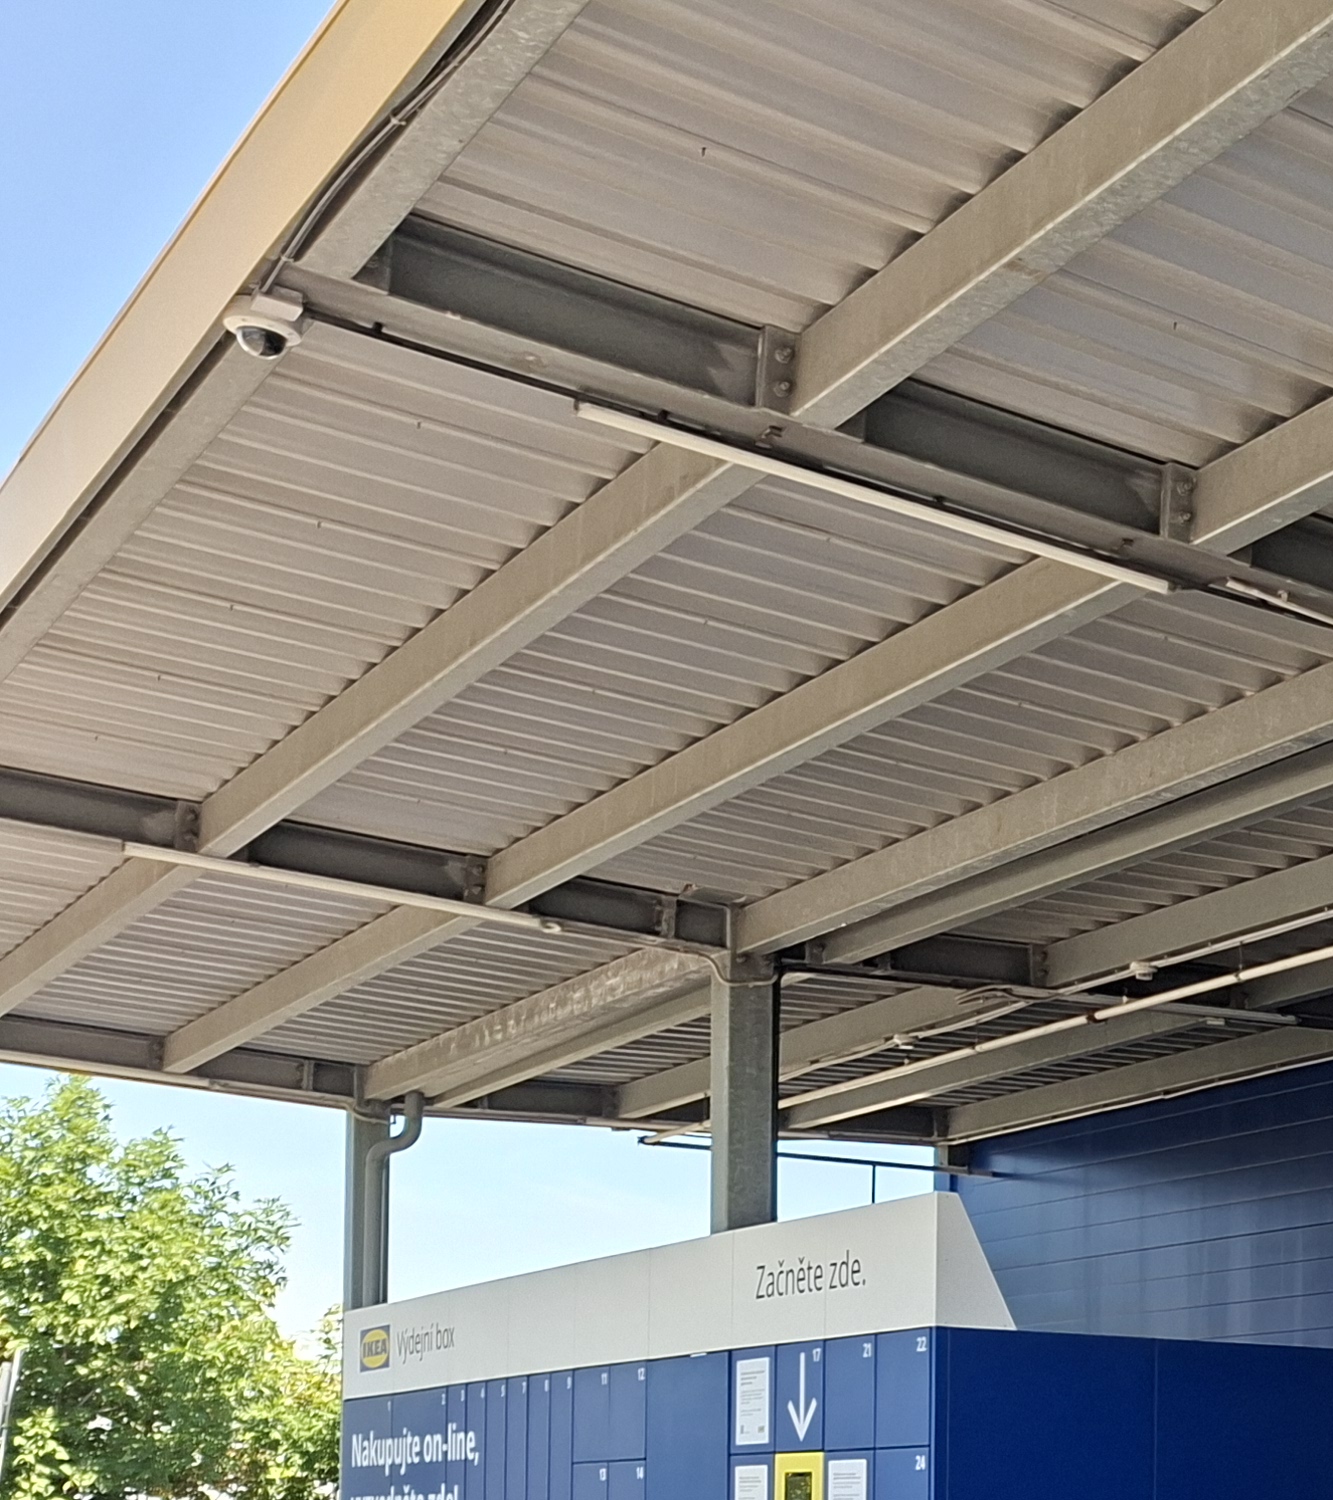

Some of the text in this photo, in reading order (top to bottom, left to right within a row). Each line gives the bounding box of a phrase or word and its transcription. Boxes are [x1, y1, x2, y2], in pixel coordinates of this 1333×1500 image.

[755, 1249, 866, 1300] Začněte zde.
[363, 1339, 388, 1359] IKEA
[397, 1322, 455, 1364] Výdejní box
[862, 1343, 872, 1358] 21
[916, 1336, 927, 1352] 22
[812, 1347, 822, 1362] 17
[637, 1367, 645, 1381] 12
[351, 1422, 479, 1477] Nakupujte on-line,
[915, 1455, 926, 1471] 24
